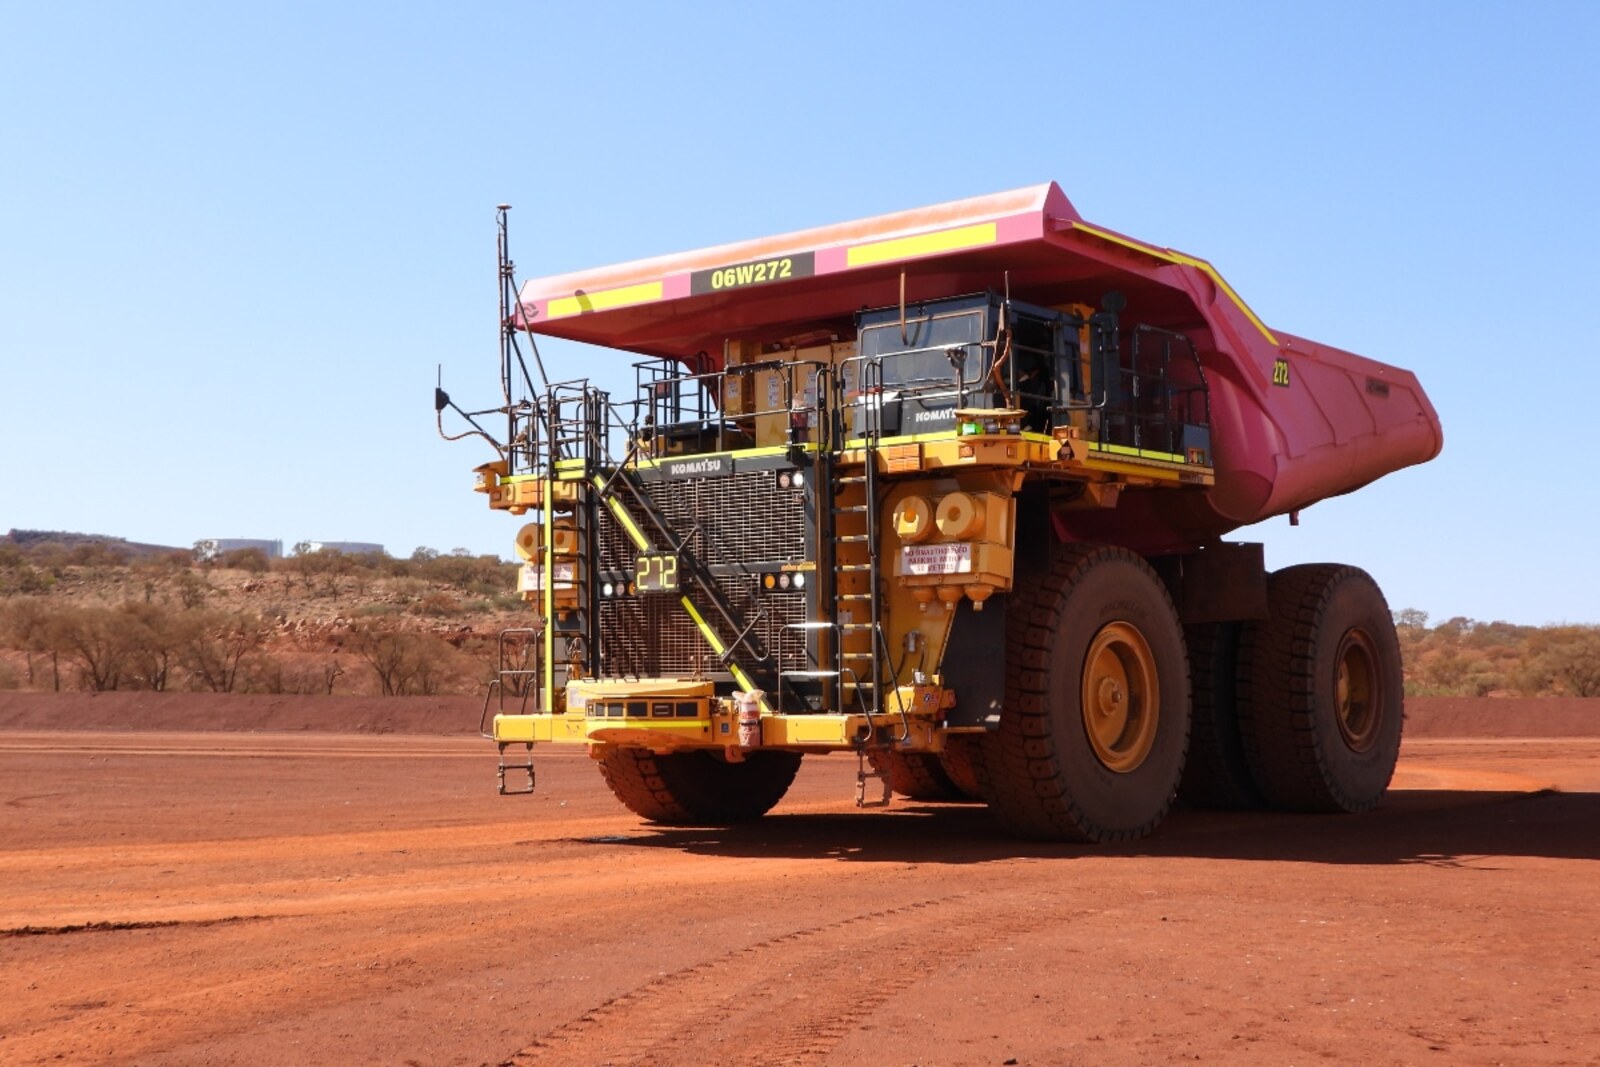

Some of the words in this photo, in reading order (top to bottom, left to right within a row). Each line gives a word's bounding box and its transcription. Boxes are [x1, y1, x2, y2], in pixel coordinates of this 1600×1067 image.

[711, 258, 792, 289] 06W272
[1273, 360, 1289, 385] 272
[915, 407, 957, 422] KOMATS
[671, 458, 721, 475] KOMATSU
[636, 555, 677, 590] 272
